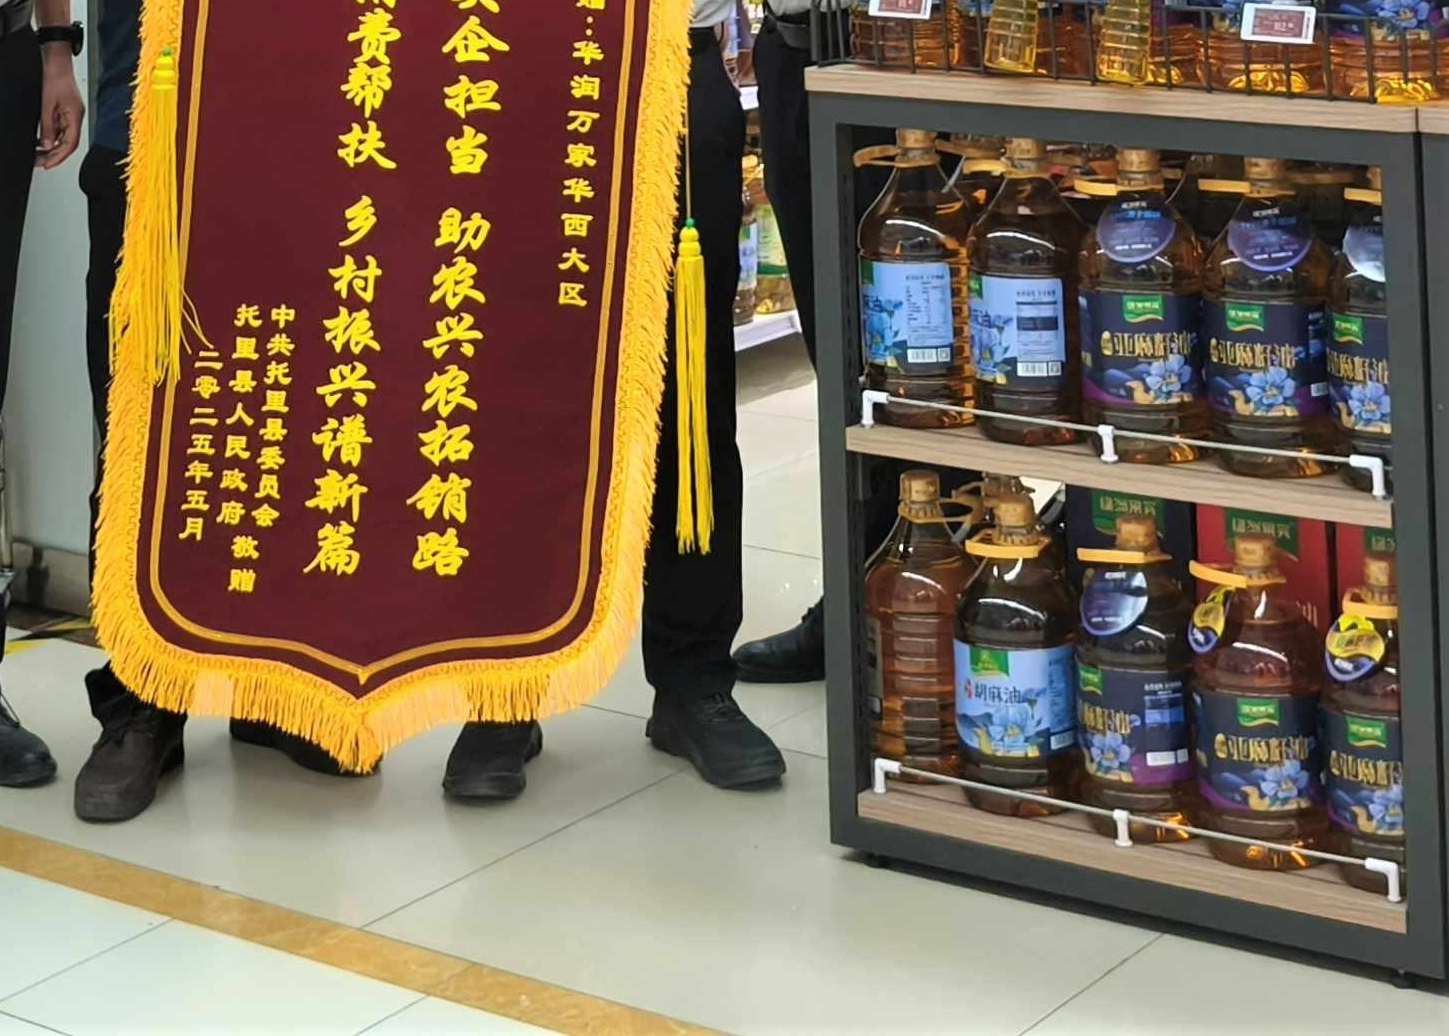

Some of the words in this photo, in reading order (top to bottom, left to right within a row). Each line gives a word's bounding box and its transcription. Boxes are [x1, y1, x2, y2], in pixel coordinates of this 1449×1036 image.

[179, 351, 224, 541] 二零二五年五月
[216, 304, 262, 526] 托里县人民政府
[251, 305, 296, 528] 中共托里县委员会
[305, 196, 383, 576] 乡村振兴谱新篇
[412, 207, 491, 576] 助农兴农拓销路
[229, 536, 260, 593] 敬赠
[975, 681, 1022, 705] 胡麻油
